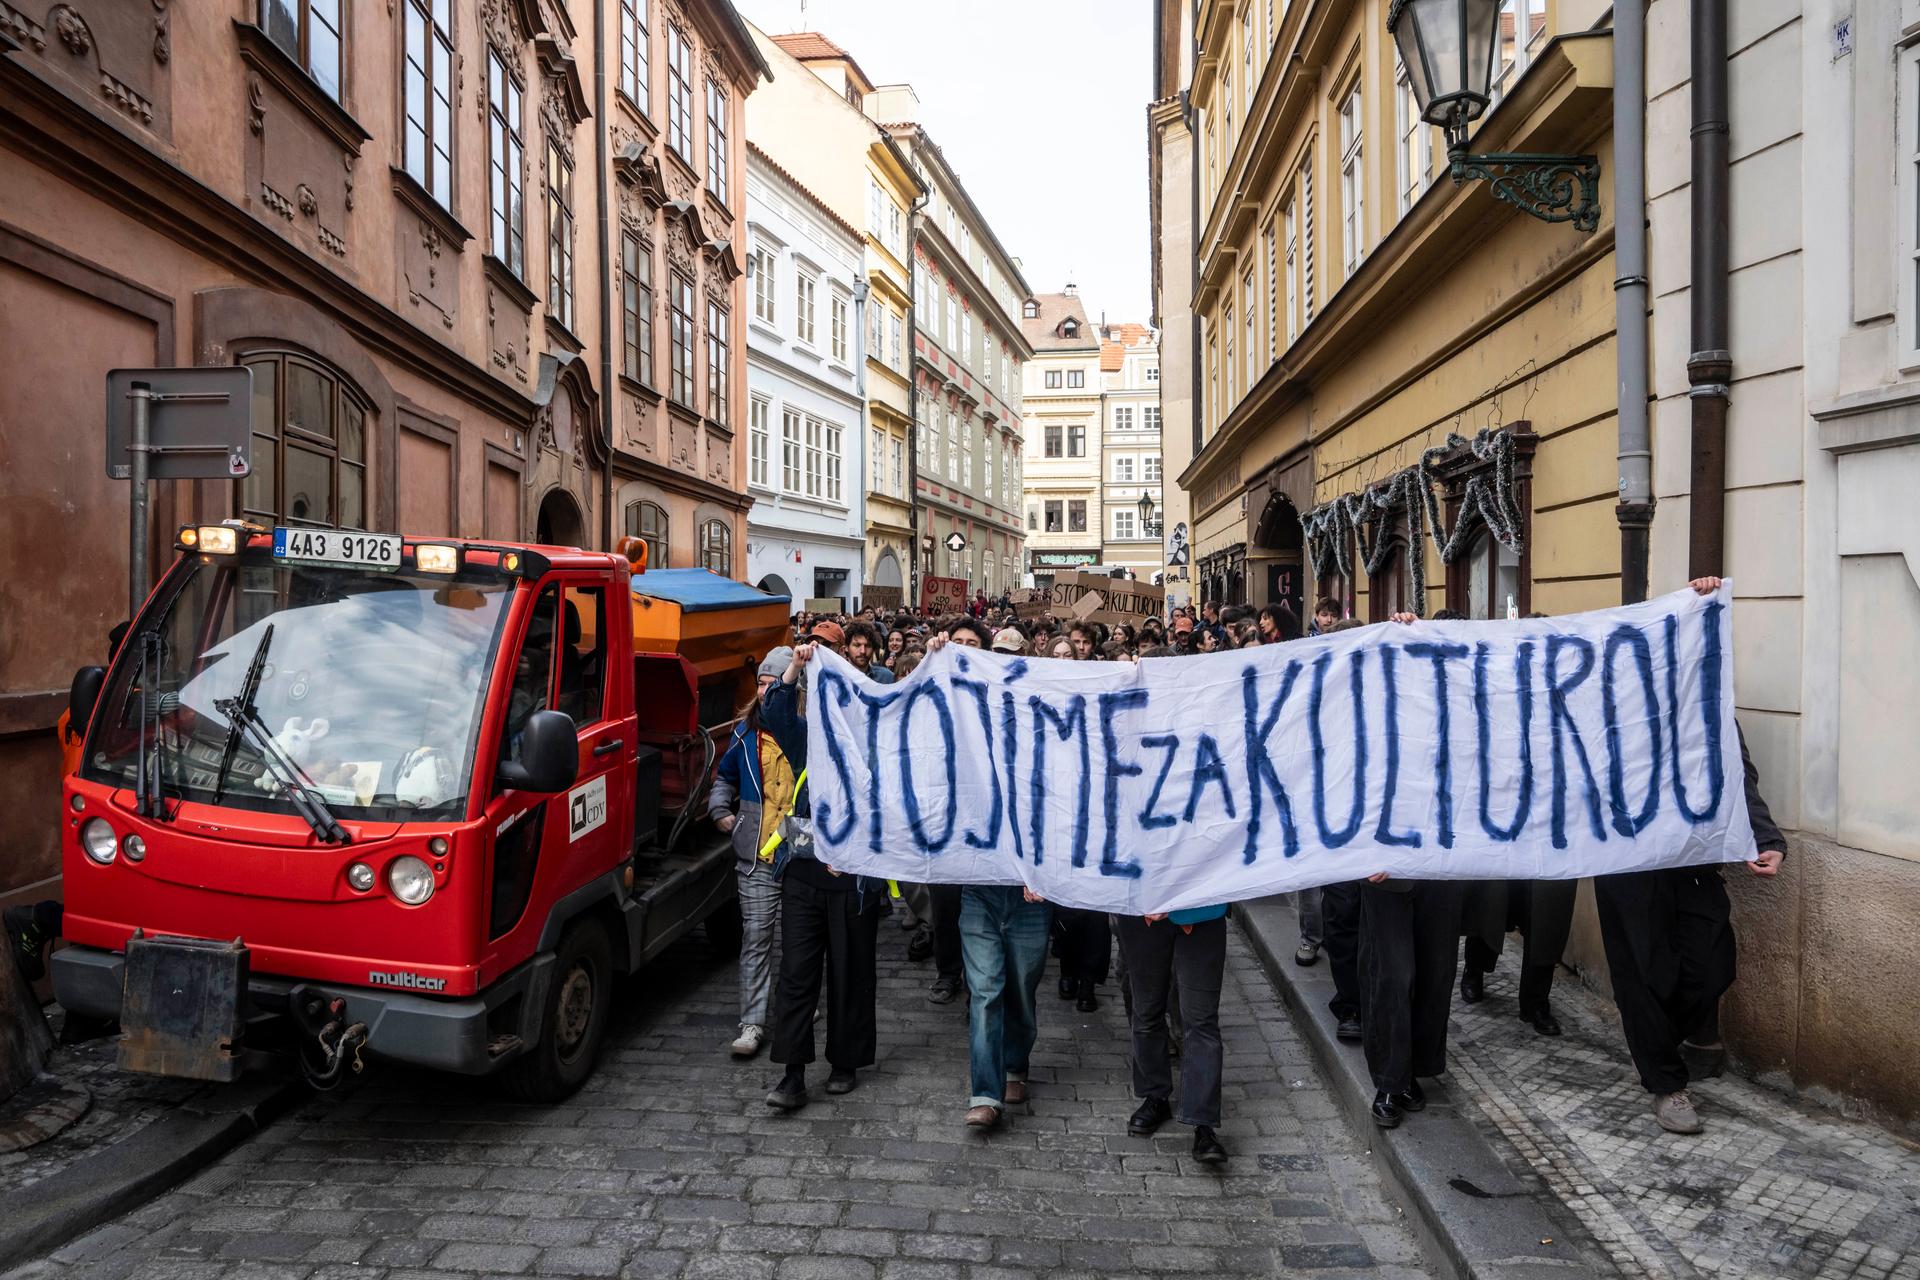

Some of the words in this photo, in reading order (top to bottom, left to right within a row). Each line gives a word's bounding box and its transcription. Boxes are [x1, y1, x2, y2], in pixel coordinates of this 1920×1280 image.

[275, 546, 286, 554] CZ
[290, 533, 327, 557] 4A3
[342, 536, 392, 562] 9126
[815, 652, 1149, 880] STOJÍME
[1138, 731, 1237, 830] ZA
[1241, 600, 1727, 867] KULTUROU
[587, 801, 605, 824] CDV
[369, 971, 446, 990] multicar
